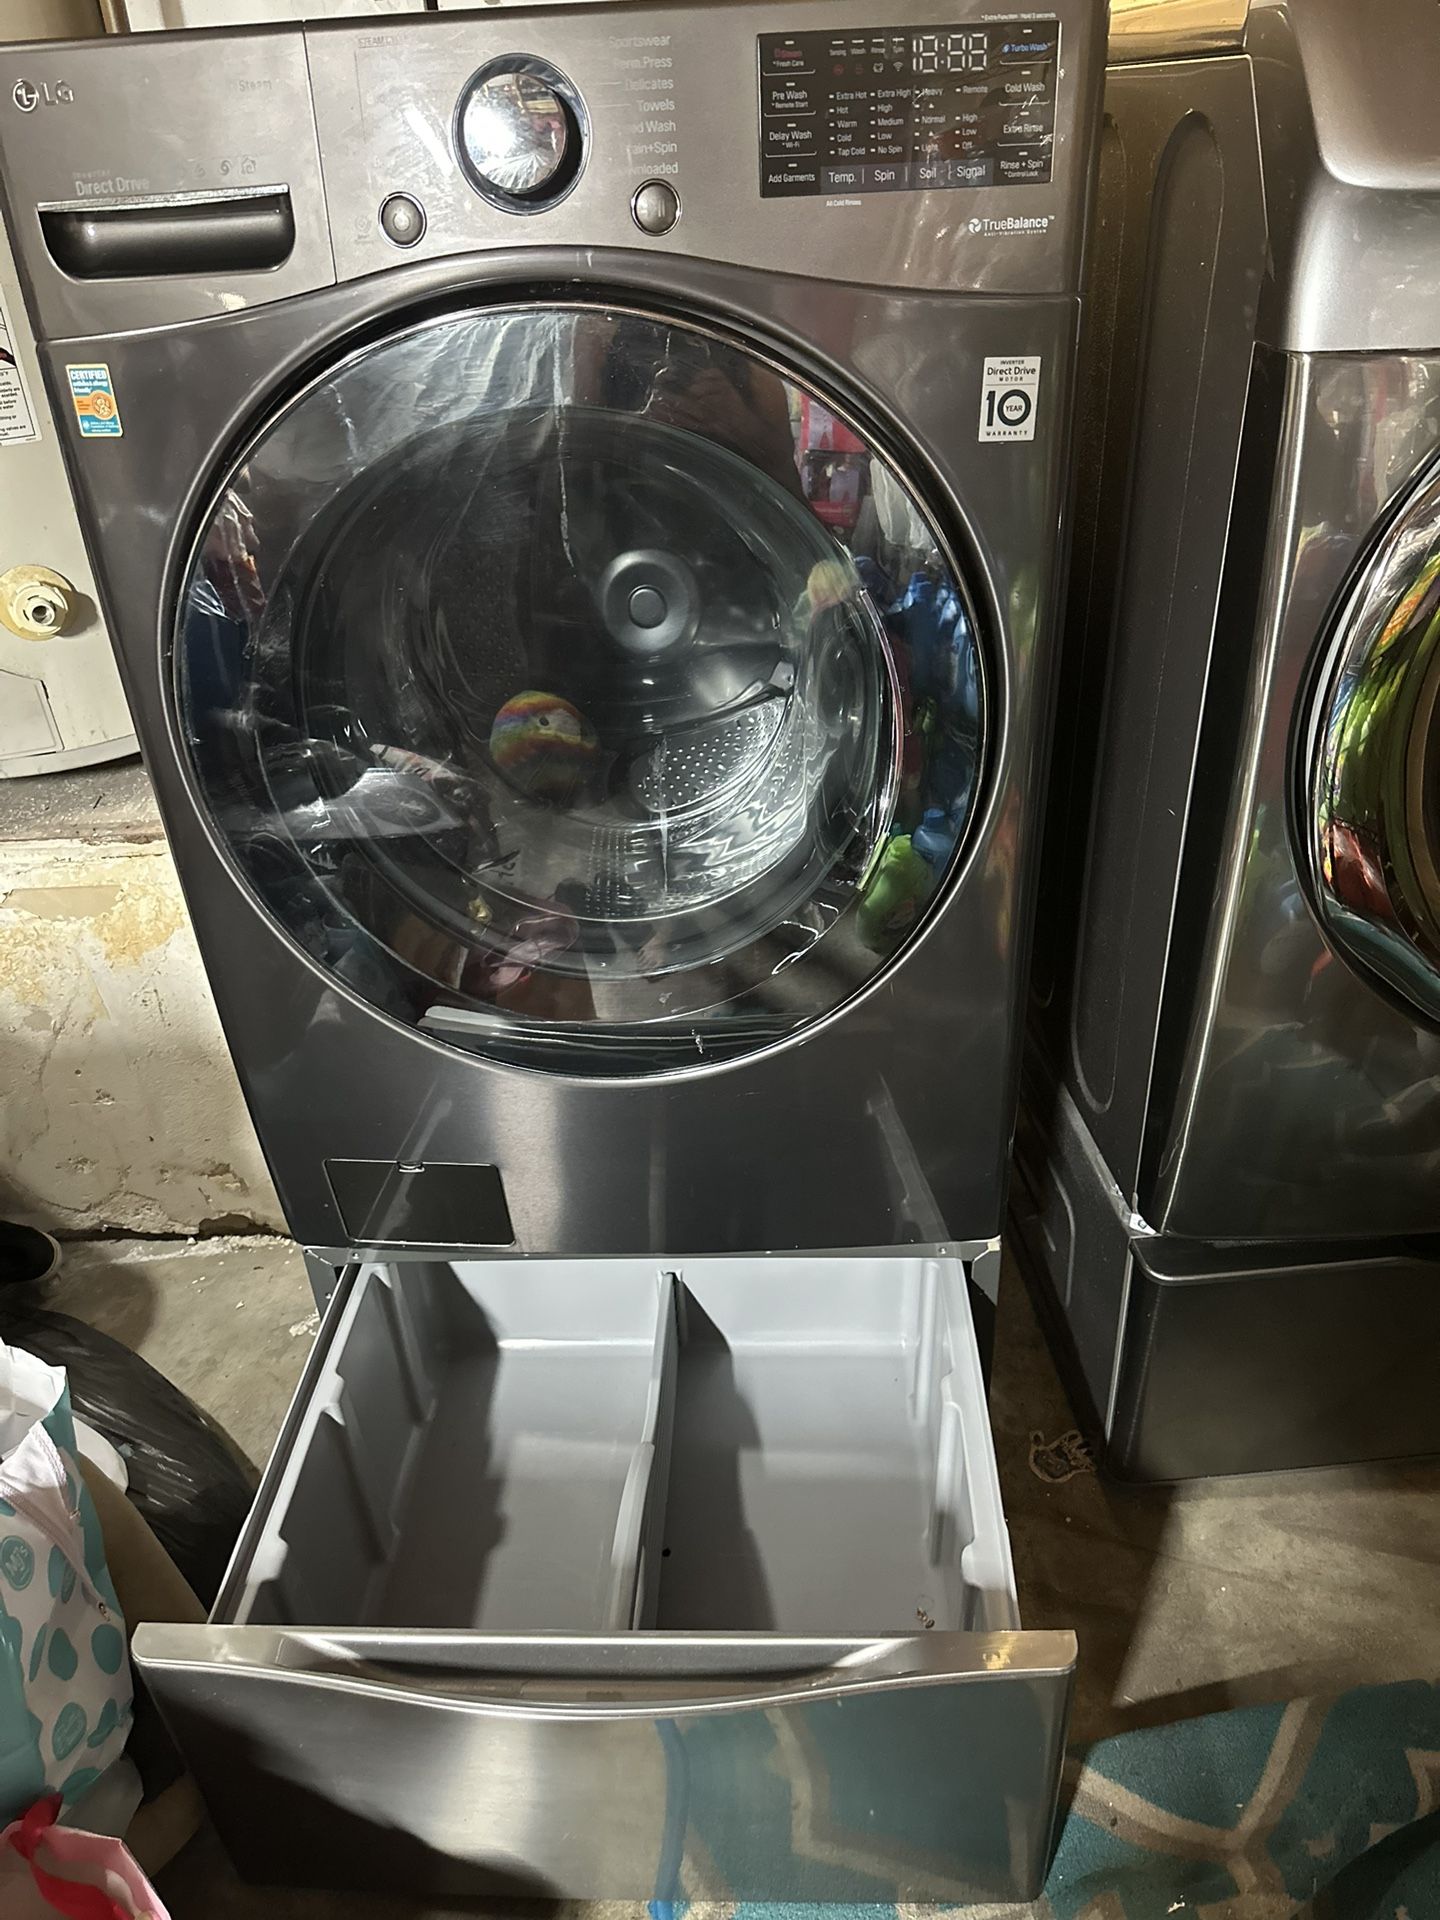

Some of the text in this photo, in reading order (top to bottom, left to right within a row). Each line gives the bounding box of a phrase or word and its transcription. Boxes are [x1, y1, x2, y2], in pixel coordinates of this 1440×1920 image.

[608, 35, 671, 49] Sportswear
[1011, 44, 1029, 52] Turbo
[624, 79, 675, 91] Delicates
[962, 85, 989, 94] Remote
[1005, 82, 1046, 93] Cold Wash
[772, 90, 808, 100] Pre Wash
[836, 91, 867, 100] Extra Hot
[877, 88, 912, 98] Extra High
[922, 88, 944, 97] Heavy
[636, 99, 675, 112] Towels
[836, 106, 849, 114] Hot
[877, 104, 893, 113] High
[877, 117, 904, 126] Medium
[921, 115, 946, 124] Normal
[962, 113, 978, 123] High
[646, 121, 677, 133] Wash
[837, 120, 858, 128] Warm
[1003, 123, 1044, 134] Extra Rinse
[769, 130, 812, 141] Delay Wash
[836, 133, 852, 142] Cold
[877, 132, 893, 140] Low
[838, 146, 866, 157] Tap Cold
[877, 145, 903, 154] No Spin
[921, 144, 939, 152] Light
[1000, 161, 1019, 169] Rinse
[1027, 160, 1044, 169] Spin
[874, 169, 895, 182] Spin
[920, 167, 937, 179] Soil
[956, 164, 986, 179] Signal
[768, 173, 816, 183] Add Garments
[828, 171, 857, 184] Temp.
[75, 177, 150, 196] Direct Drive
[70, 370, 107, 381] CERTIFIED
[987, 366, 1036, 376] Direct Drive
[986, 389, 1032, 426] 10
[1005, 404, 1023, 412] YEAR
